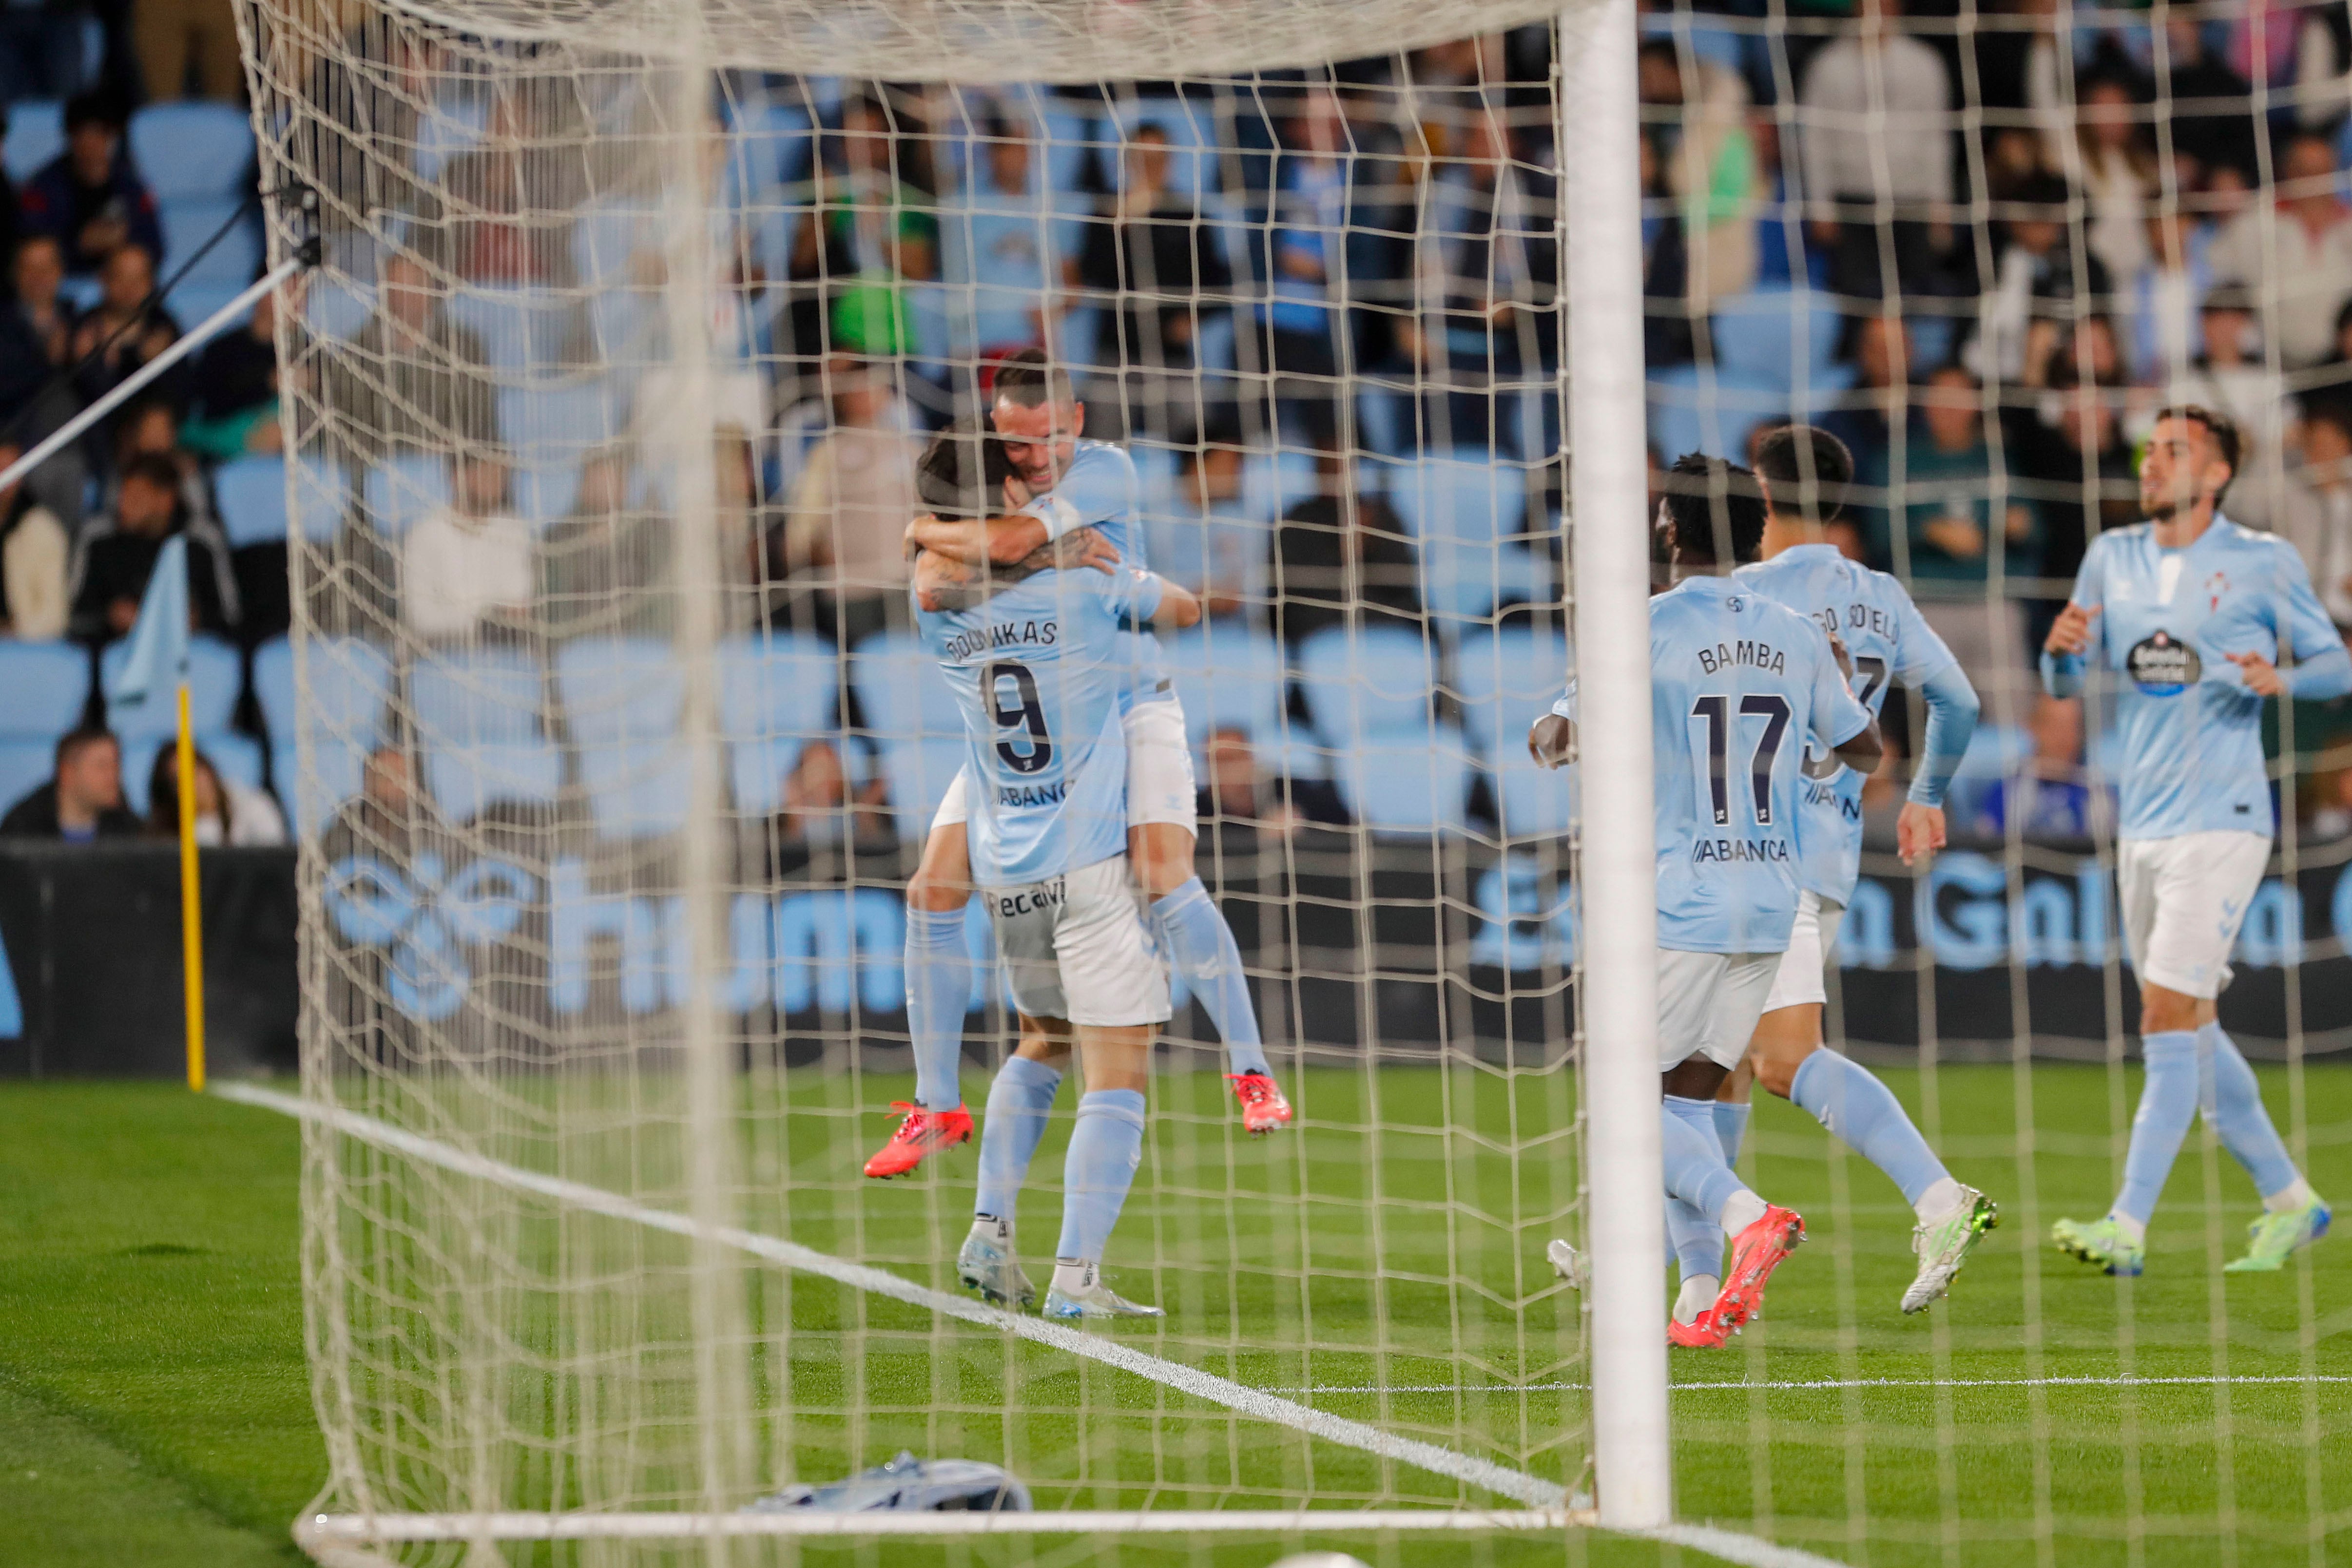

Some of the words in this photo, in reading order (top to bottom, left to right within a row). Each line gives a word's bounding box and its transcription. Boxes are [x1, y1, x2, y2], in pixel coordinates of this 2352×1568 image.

[1697, 639, 1785, 677] BAMBA
[978, 662, 1053, 776] 9
[1690, 694, 1793, 827] 17
